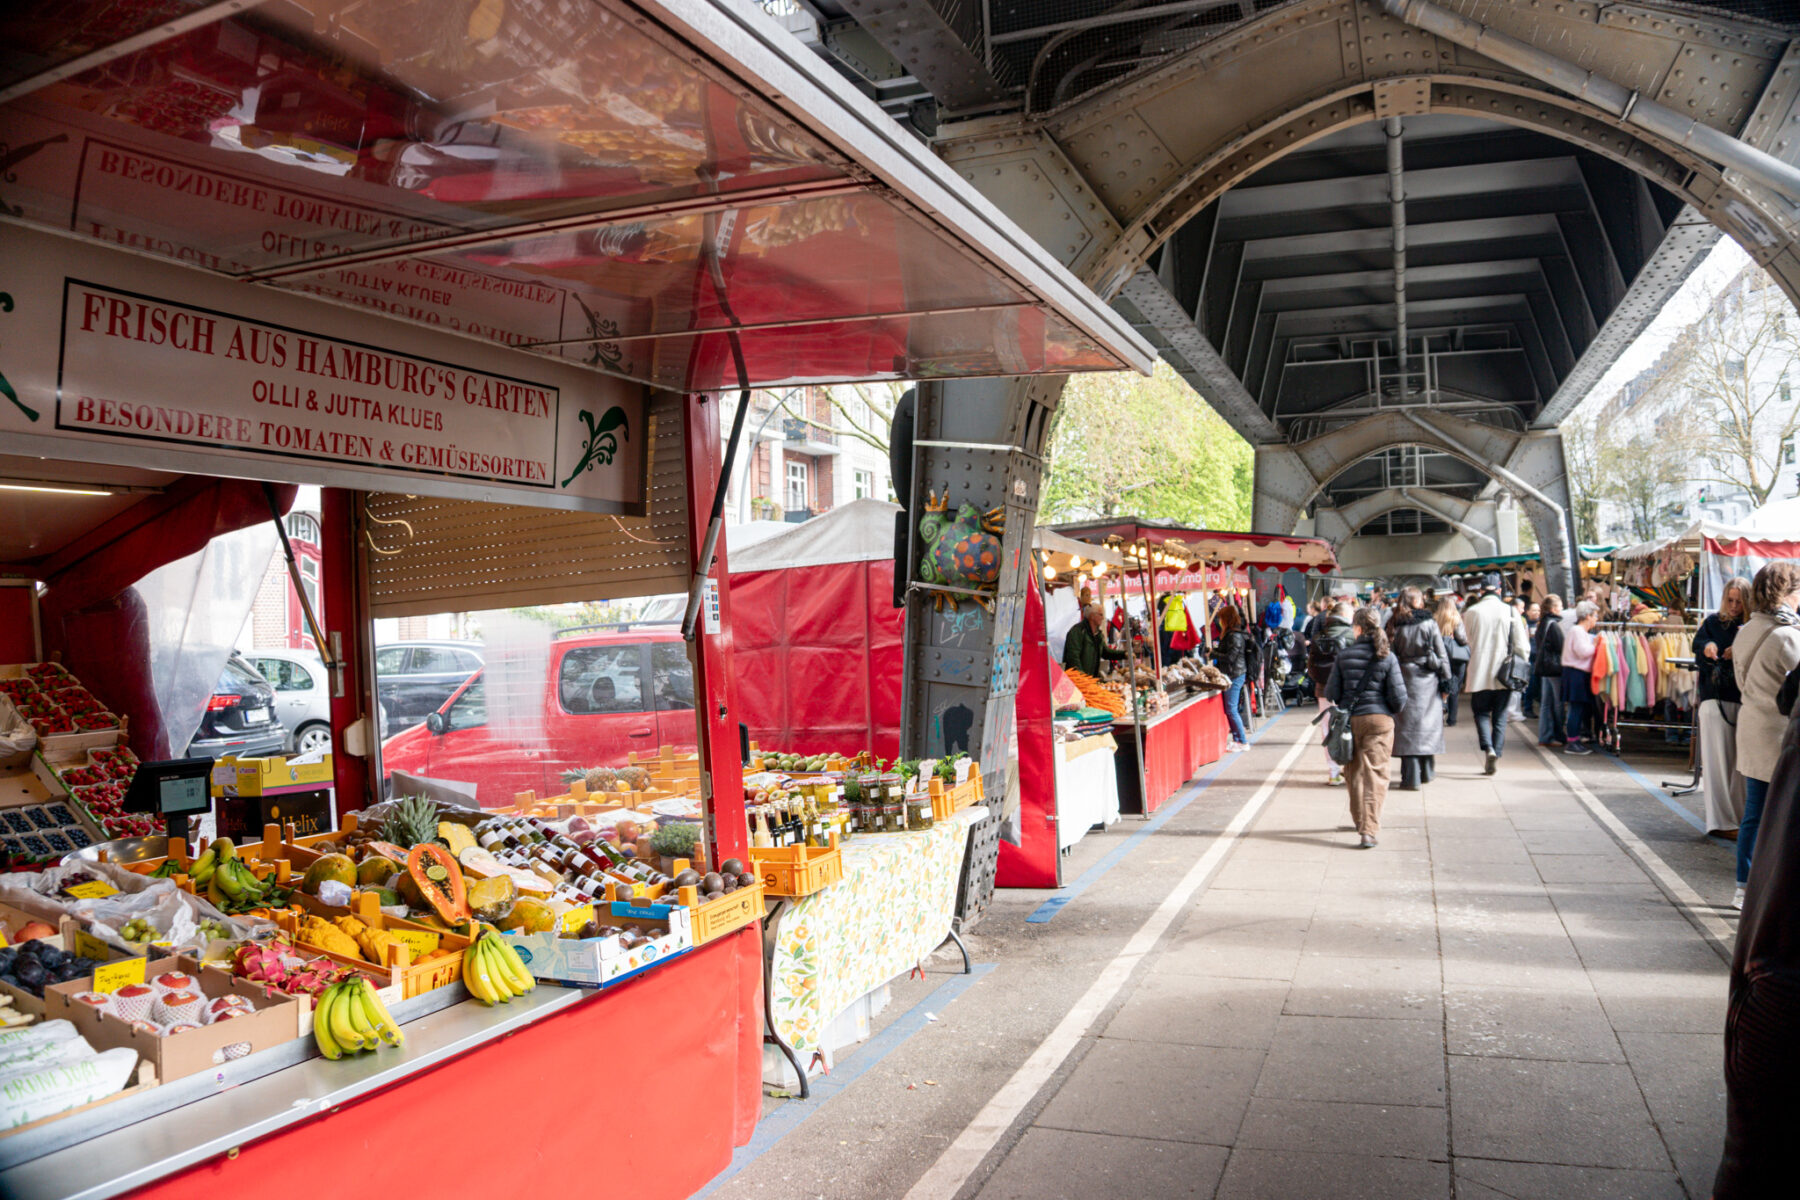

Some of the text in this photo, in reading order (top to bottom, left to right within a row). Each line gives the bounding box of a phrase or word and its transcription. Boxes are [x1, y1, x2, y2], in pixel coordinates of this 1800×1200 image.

[80, 292, 217, 356] FRISCH
[224, 324, 287, 368] AUS
[462, 375, 551, 419] GARTEN
[252, 379, 443, 432] OLLI & JUTTA KLUEß
[74, 396, 547, 481] BESONDERE TOMATEN & GEMÜSESORTEN
[1157, 575, 1168, 585] in
[1169, 572, 1220, 585] Hmbrg
[281, 814, 319, 836] Helix
